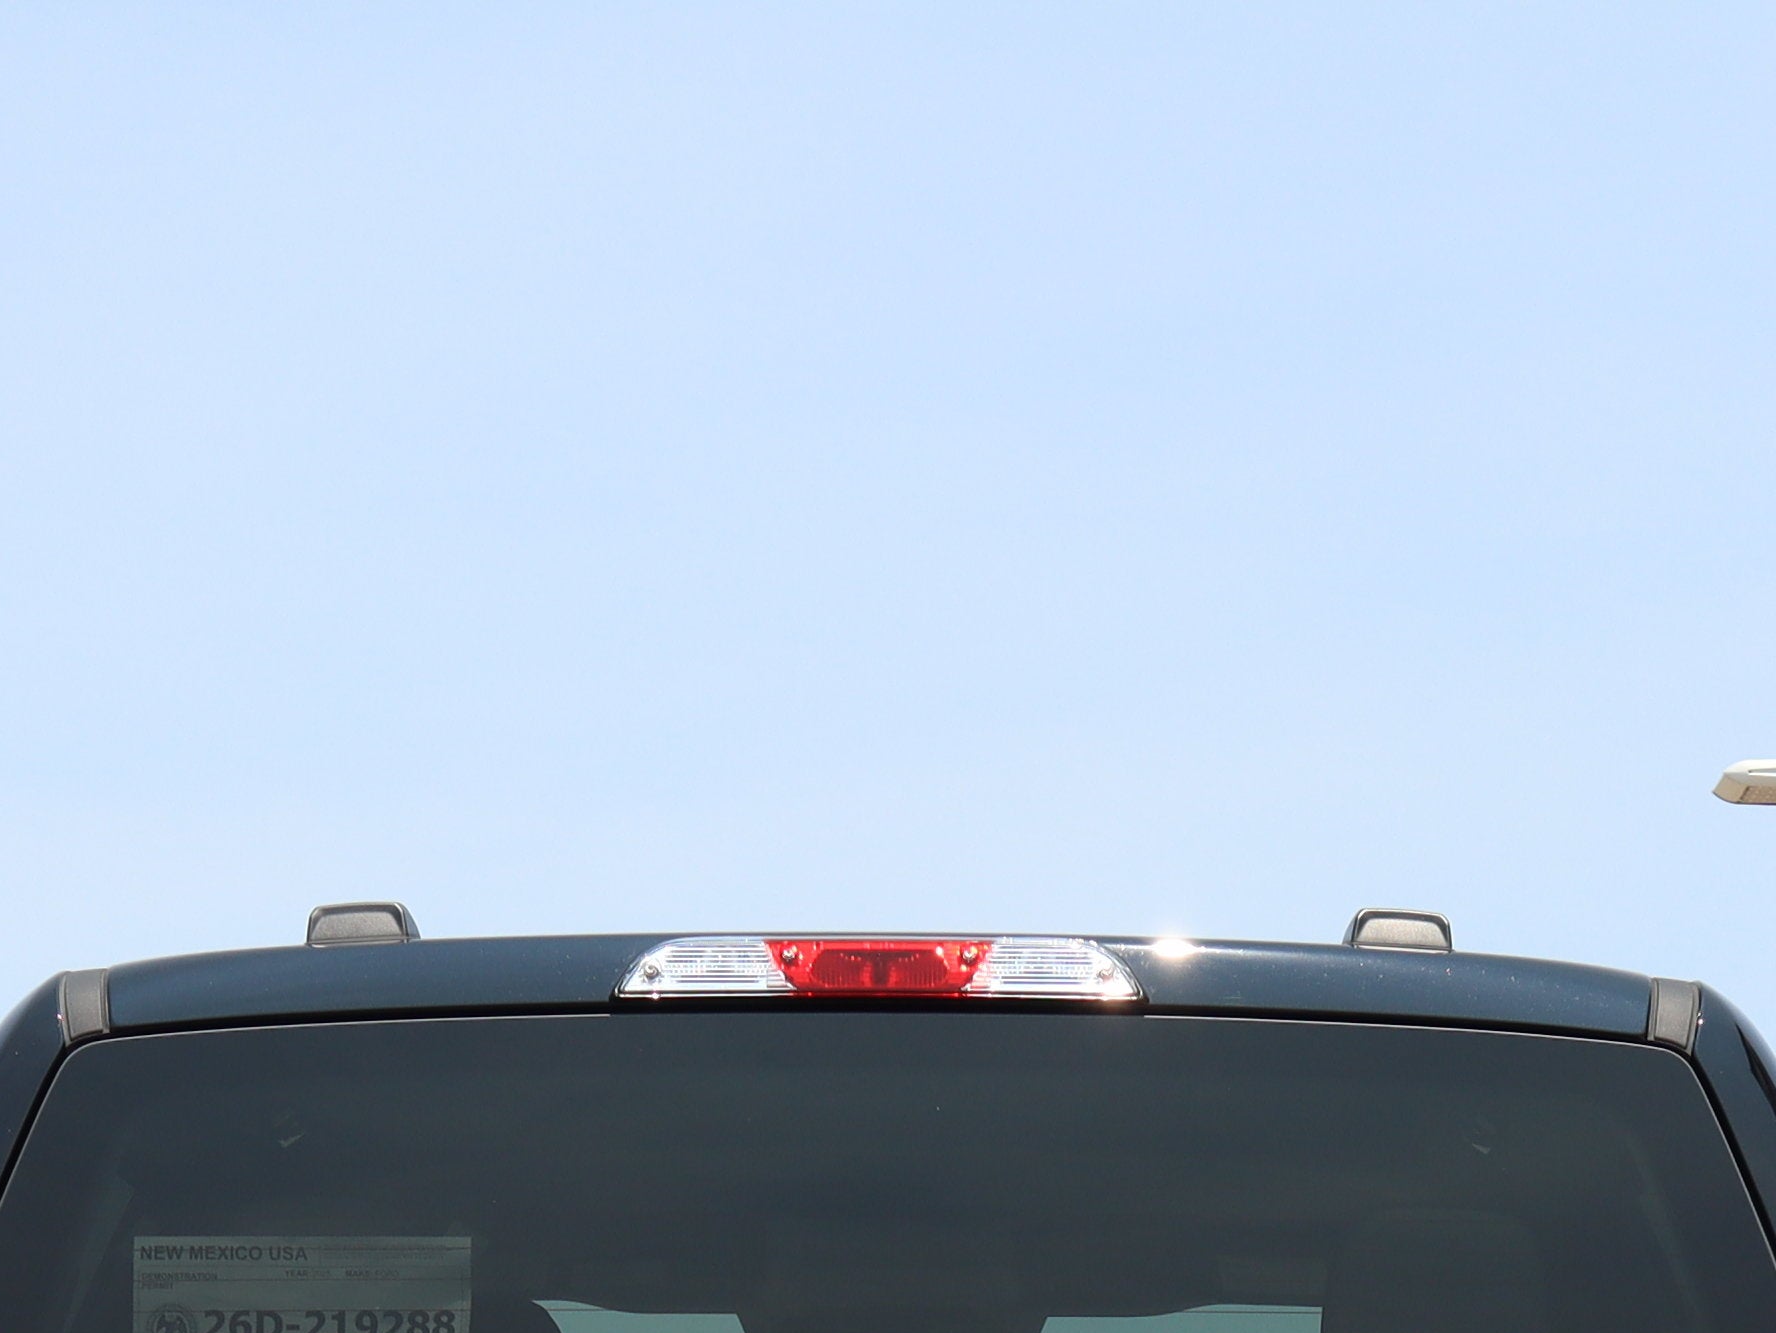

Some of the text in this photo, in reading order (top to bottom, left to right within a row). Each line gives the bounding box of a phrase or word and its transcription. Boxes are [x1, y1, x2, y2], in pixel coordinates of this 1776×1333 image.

[140, 1245, 183, 1261] NEW
[189, 1245, 263, 1261] MEXICO
[269, 1246, 308, 1261] USA
[141, 1272, 218, 1281] DEMONSTRATION
